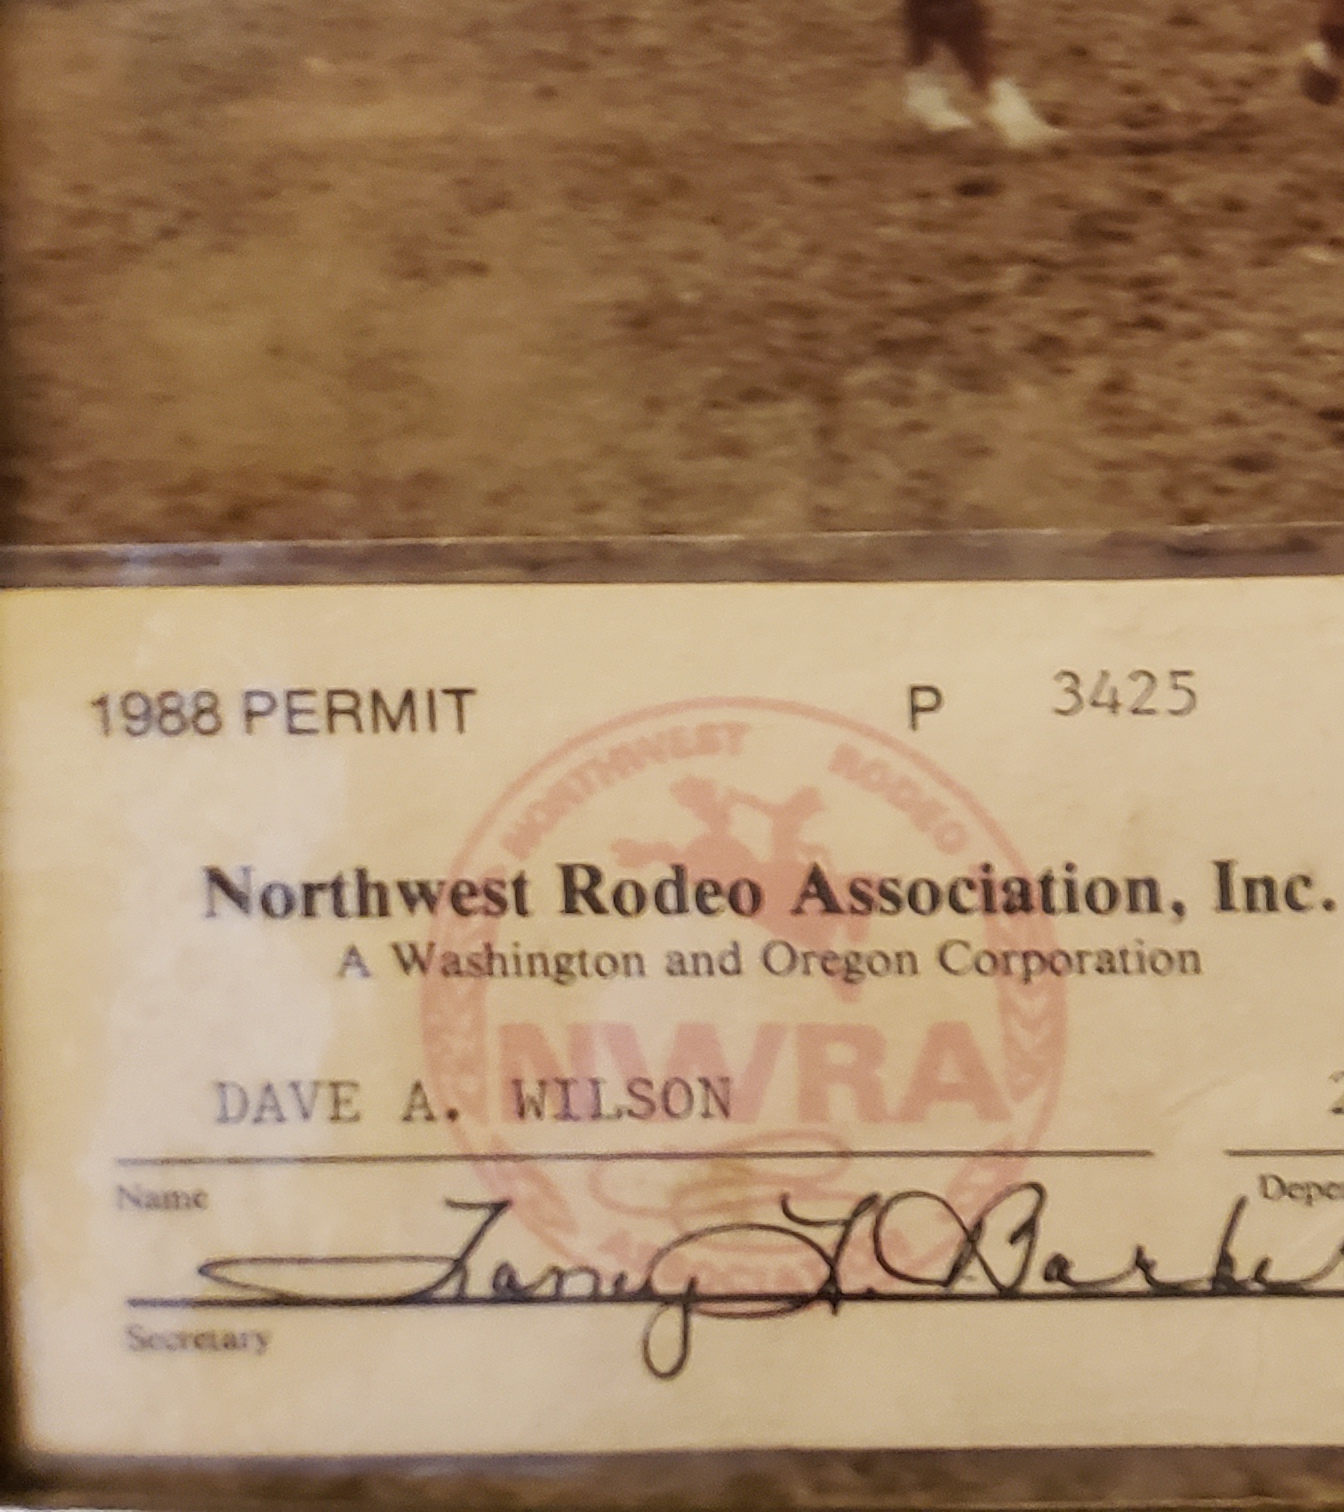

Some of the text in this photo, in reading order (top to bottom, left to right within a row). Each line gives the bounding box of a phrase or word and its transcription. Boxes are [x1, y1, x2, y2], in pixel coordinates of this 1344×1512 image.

[90, 688, 477, 737] 1988 PERMIT
[907, 685, 943, 730] P
[1051, 668, 1199, 717] 3425
[203, 859, 1338, 921] Northwest Rodeo Association, Inc.
[337, 937, 1202, 986] A Washington and Oregon Corporation
[500, 1021, 1012, 1124] NWRA
[213, 1077, 733, 1124] DAVE A. WILSON
[116, 1184, 209, 1213] Name
[124, 1324, 271, 1357] Secretary
